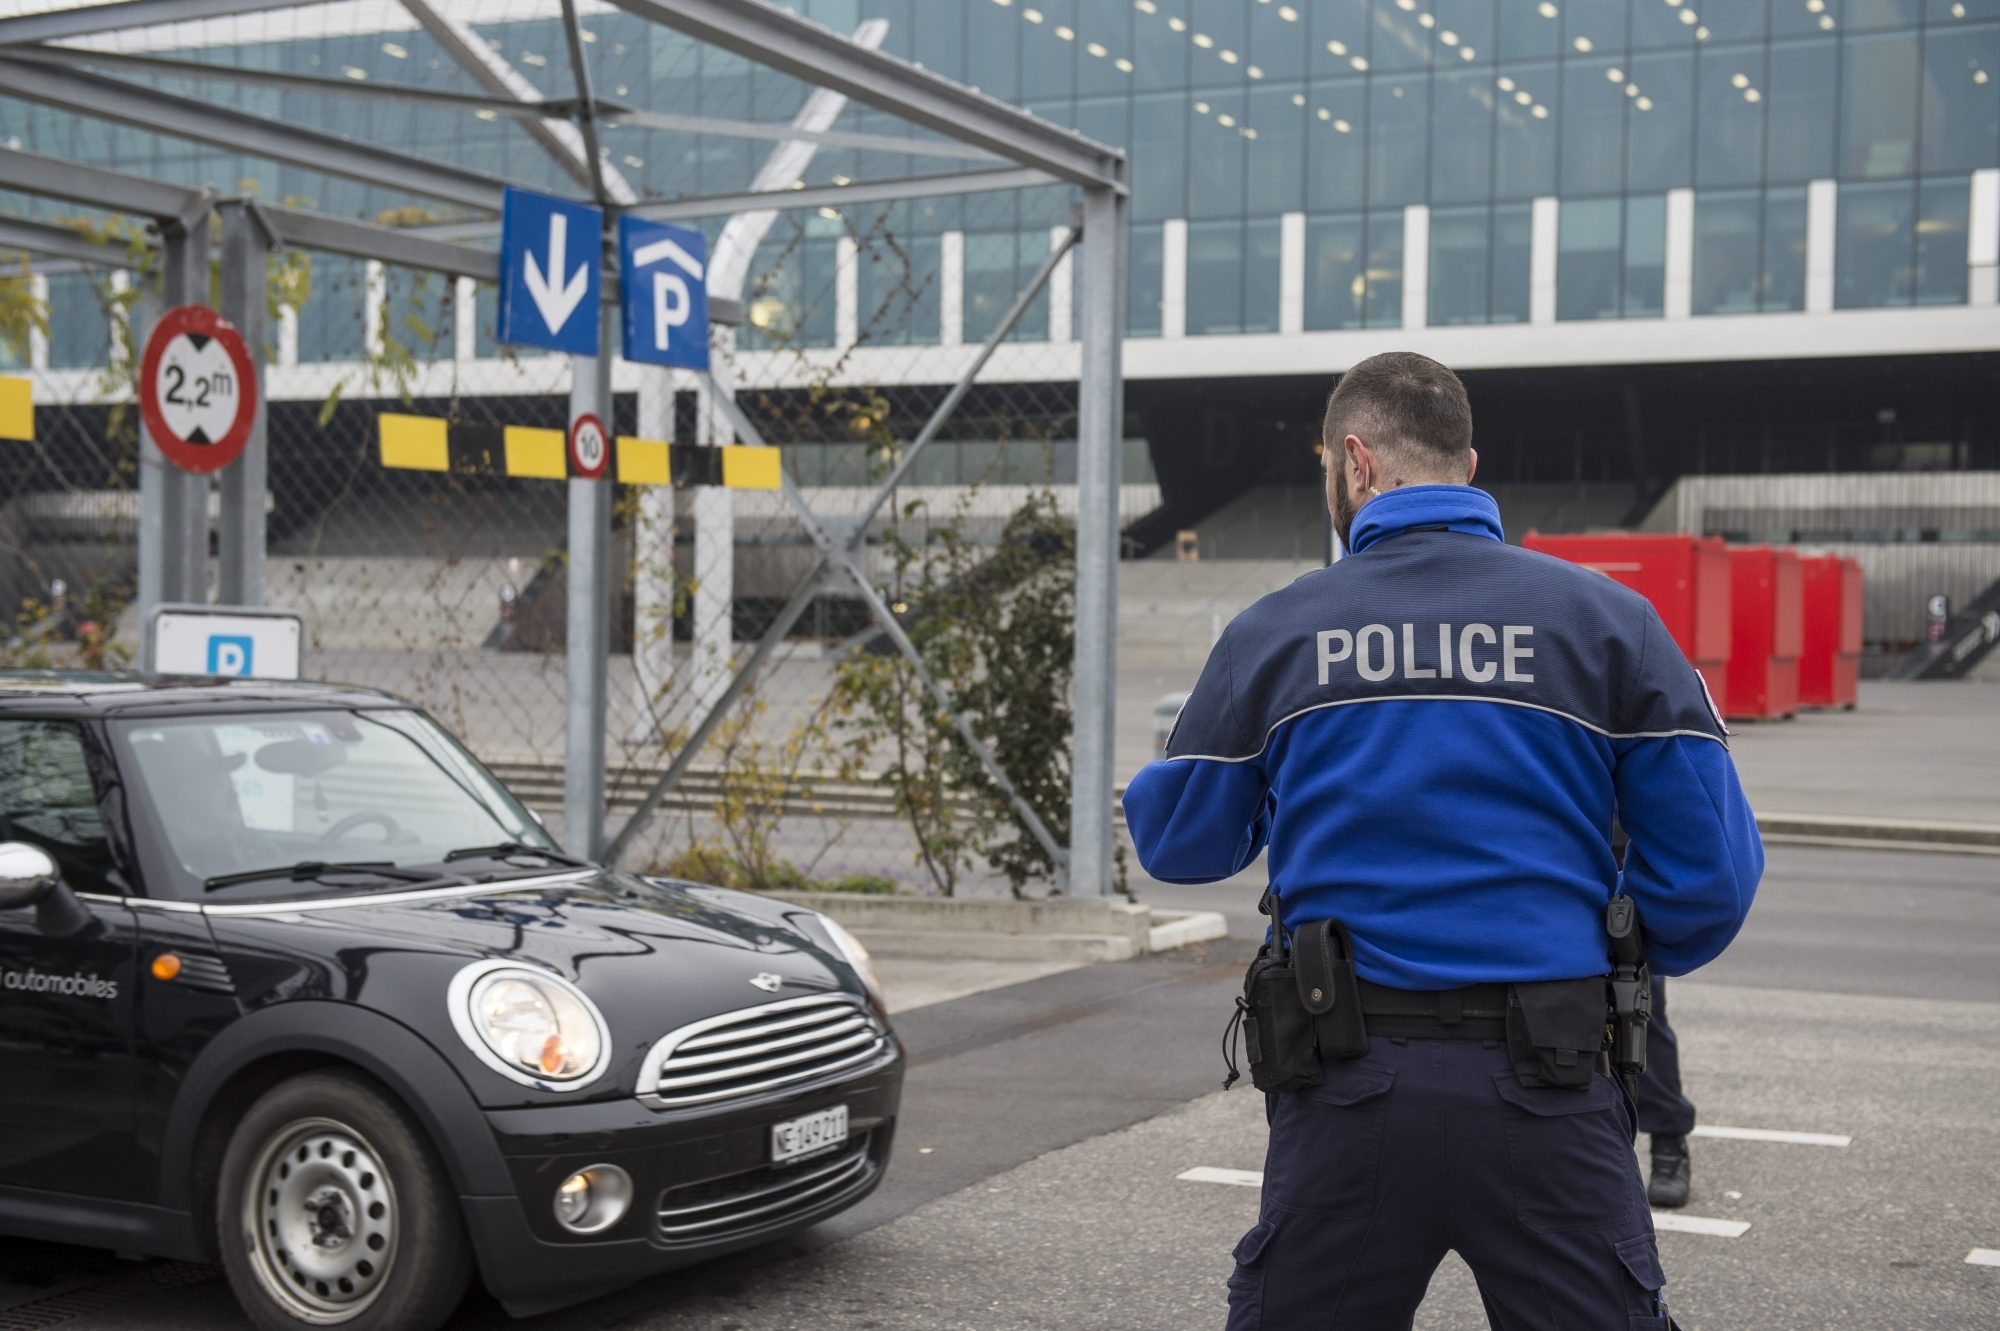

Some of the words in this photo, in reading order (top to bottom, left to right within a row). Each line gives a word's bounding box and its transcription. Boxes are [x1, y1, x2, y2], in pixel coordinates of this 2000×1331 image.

[653, 271, 690, 351] P
[581, 432, 599, 460] 10
[1317, 623, 1535, 686] POLICE
[4, 966, 119, 999] automobiles
